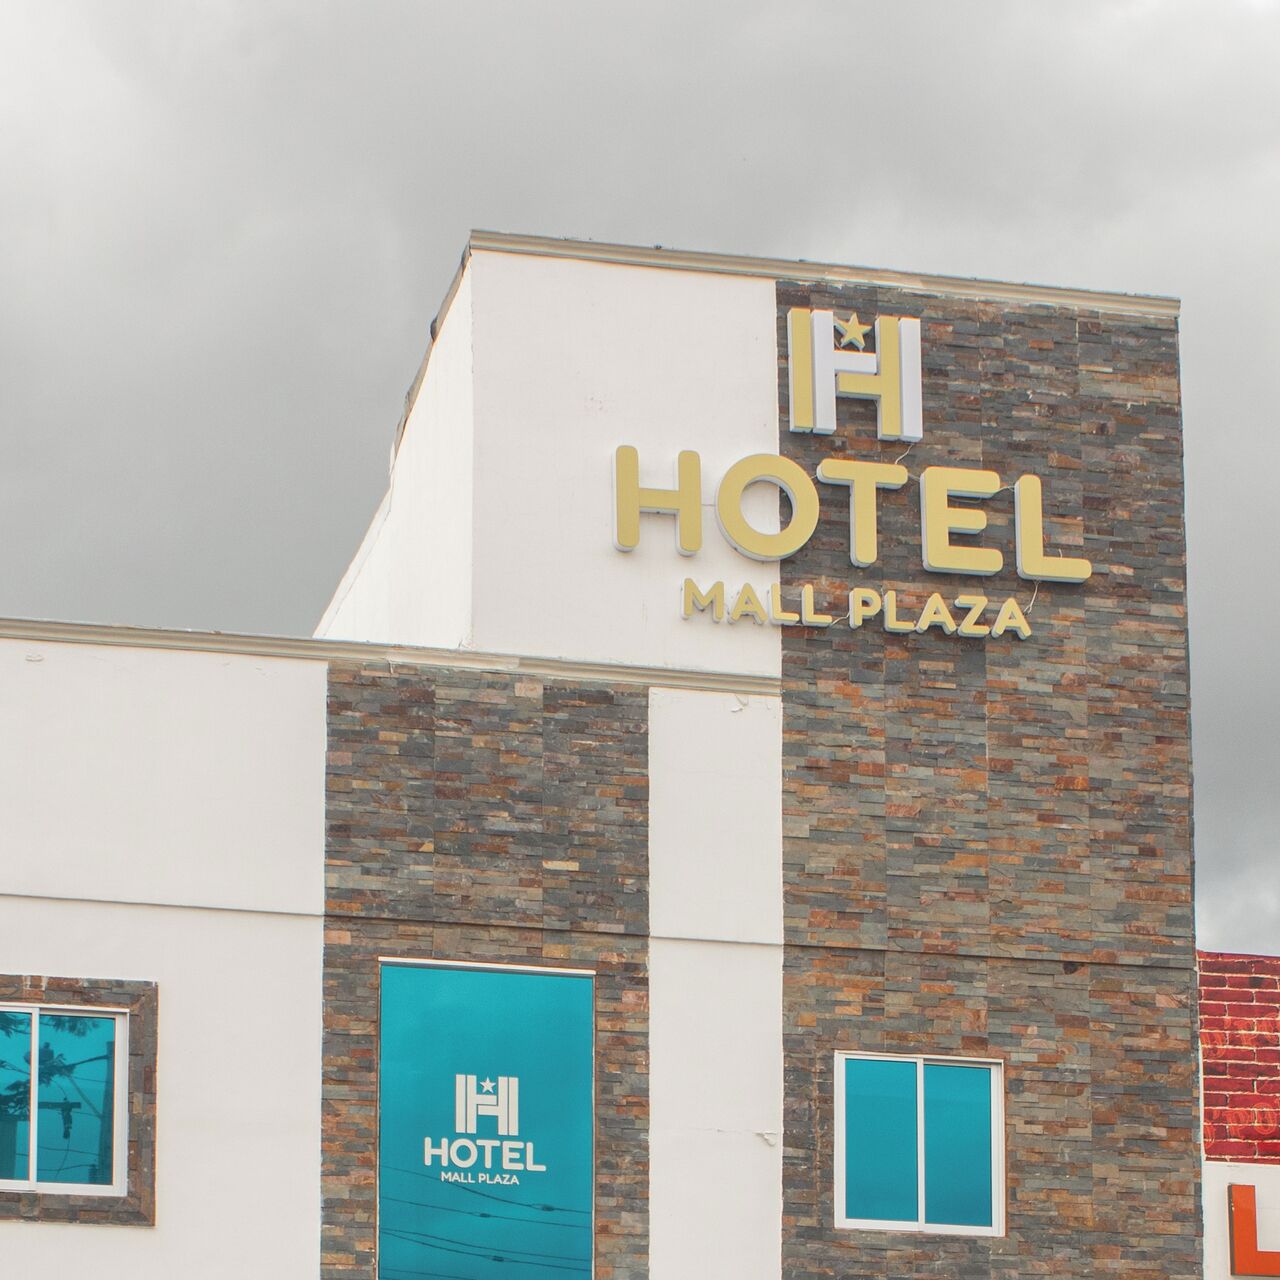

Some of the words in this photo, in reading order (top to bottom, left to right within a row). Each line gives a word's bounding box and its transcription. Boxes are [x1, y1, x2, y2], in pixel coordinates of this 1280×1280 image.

[612, 445, 1092, 583] HOTEL
[680, 578, 832, 626] MALL
[850, 588, 1032, 640] PLAZA
[424, 1137, 547, 1172] HOTEL
[441, 1171, 475, 1183] MALL
[478, 1173, 519, 1185] PLAZA
